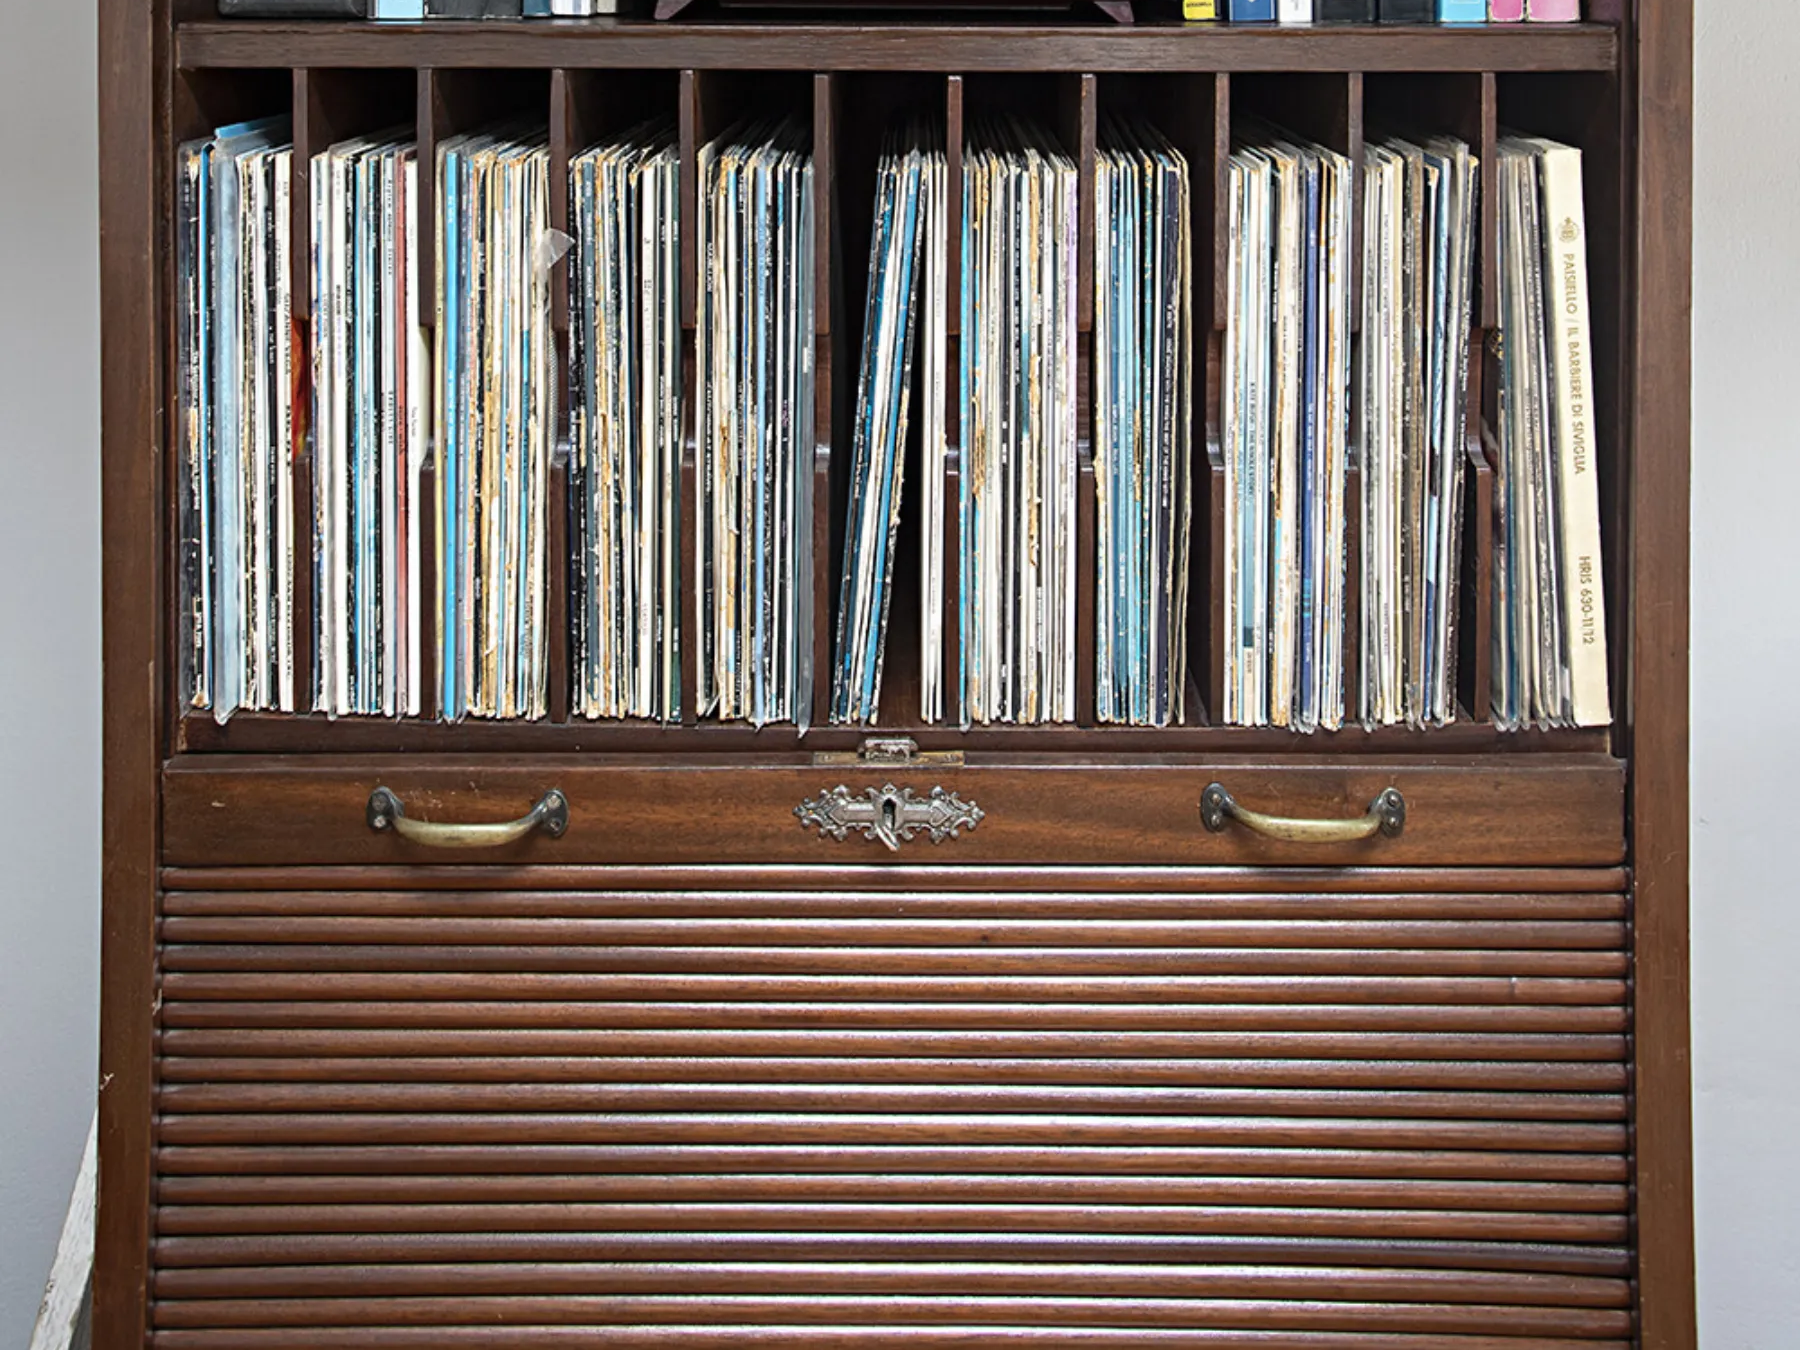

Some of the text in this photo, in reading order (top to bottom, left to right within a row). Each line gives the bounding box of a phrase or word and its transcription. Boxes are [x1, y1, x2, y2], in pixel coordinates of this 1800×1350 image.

[1563, 253, 1579, 315] PAISIELLO
[1567, 327, 1579, 338] IL
[1567, 341, 1583, 400] BARBIERE
[1570, 402, 1583, 417] DI
[1572, 417, 1587, 475] SIVIGLIA
